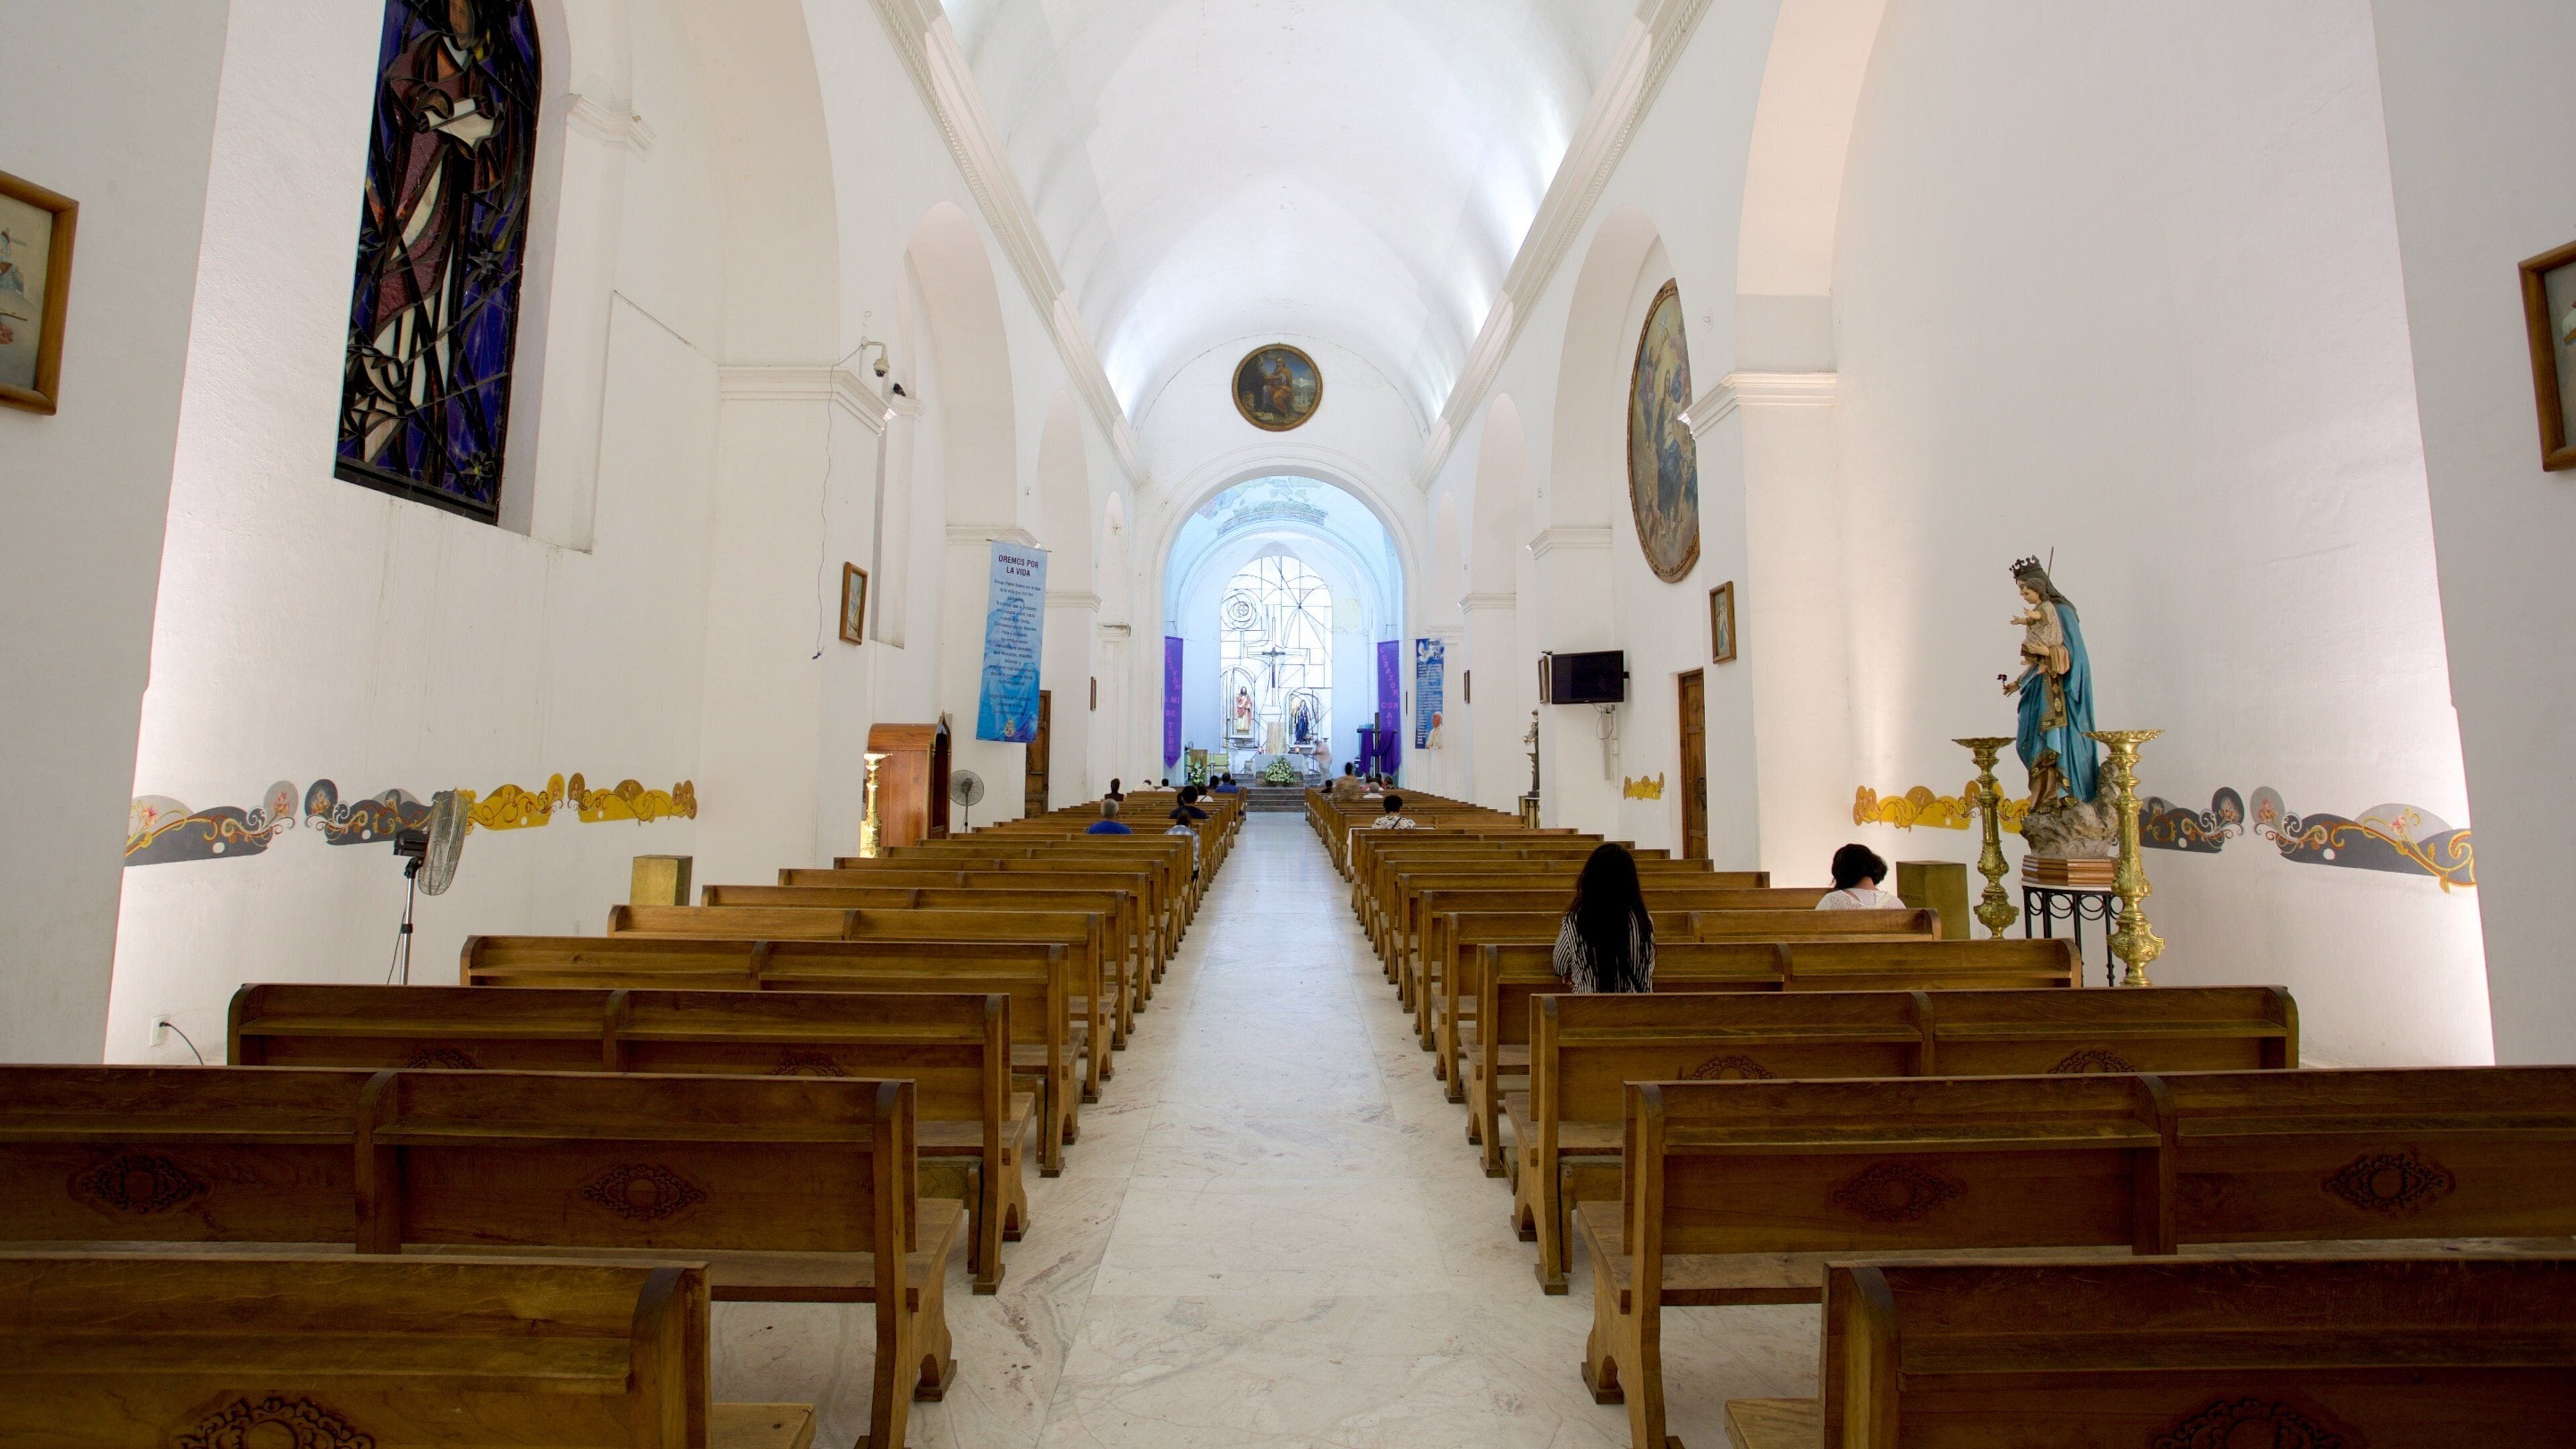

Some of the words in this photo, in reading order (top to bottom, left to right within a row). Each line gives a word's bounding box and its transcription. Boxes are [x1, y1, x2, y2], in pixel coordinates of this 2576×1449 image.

[998, 555, 1025, 566] OREMOS
[1027, 559, 1038, 569] POR
[1006, 566, 1014, 574] LA
[1016, 568, 1030, 577] VIDA
